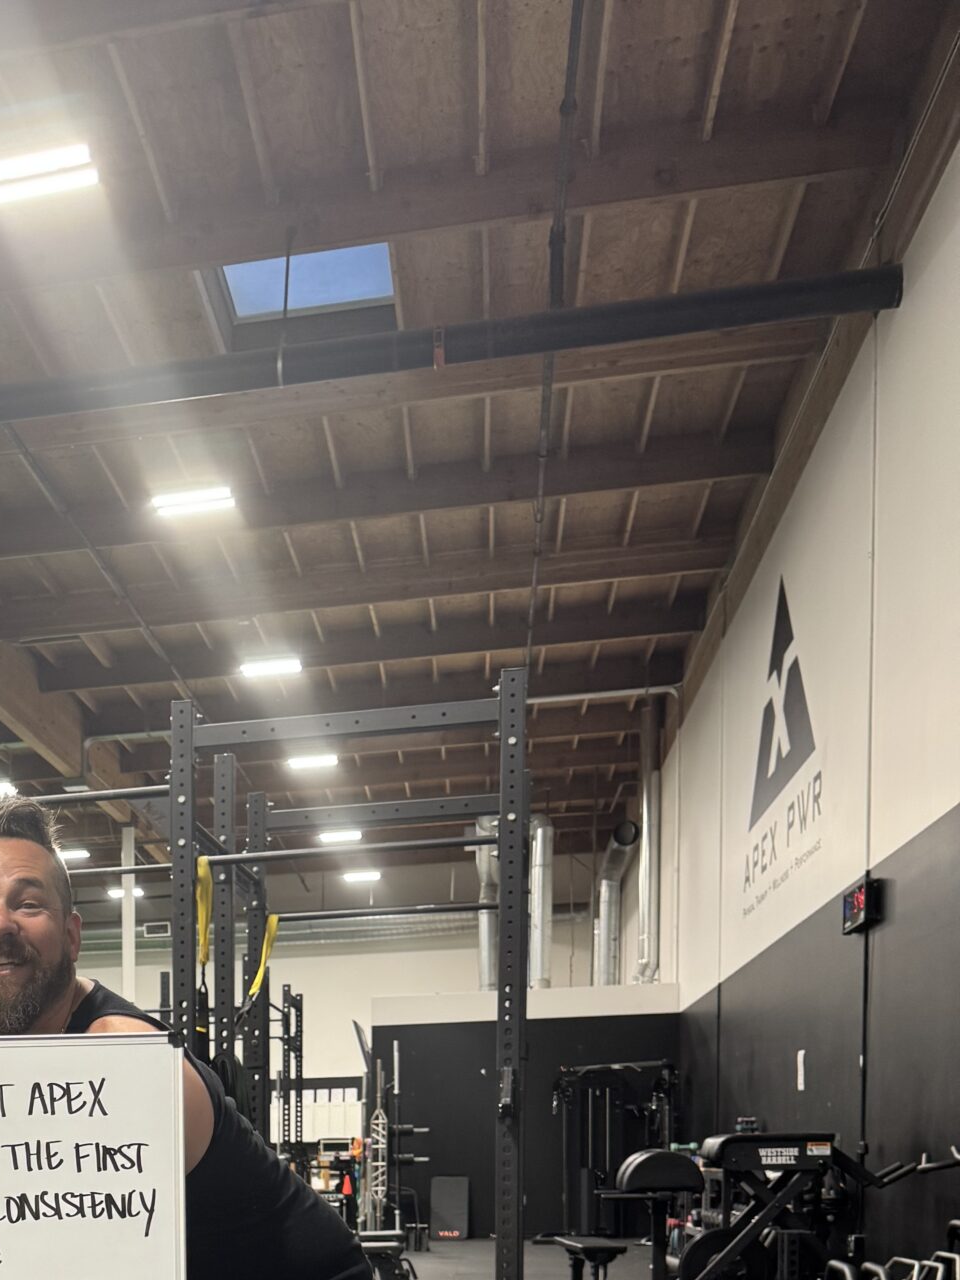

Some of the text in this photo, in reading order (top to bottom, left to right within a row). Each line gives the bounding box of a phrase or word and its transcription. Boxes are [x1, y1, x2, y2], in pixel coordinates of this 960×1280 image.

[743, 820, 777, 893] APEX
[786, 769, 822, 849] PWR
[28, 1077, 109, 1118] APEX
[0, 1140, 64, 1172] THE
[74, 1142, 150, 1173] FIRST
